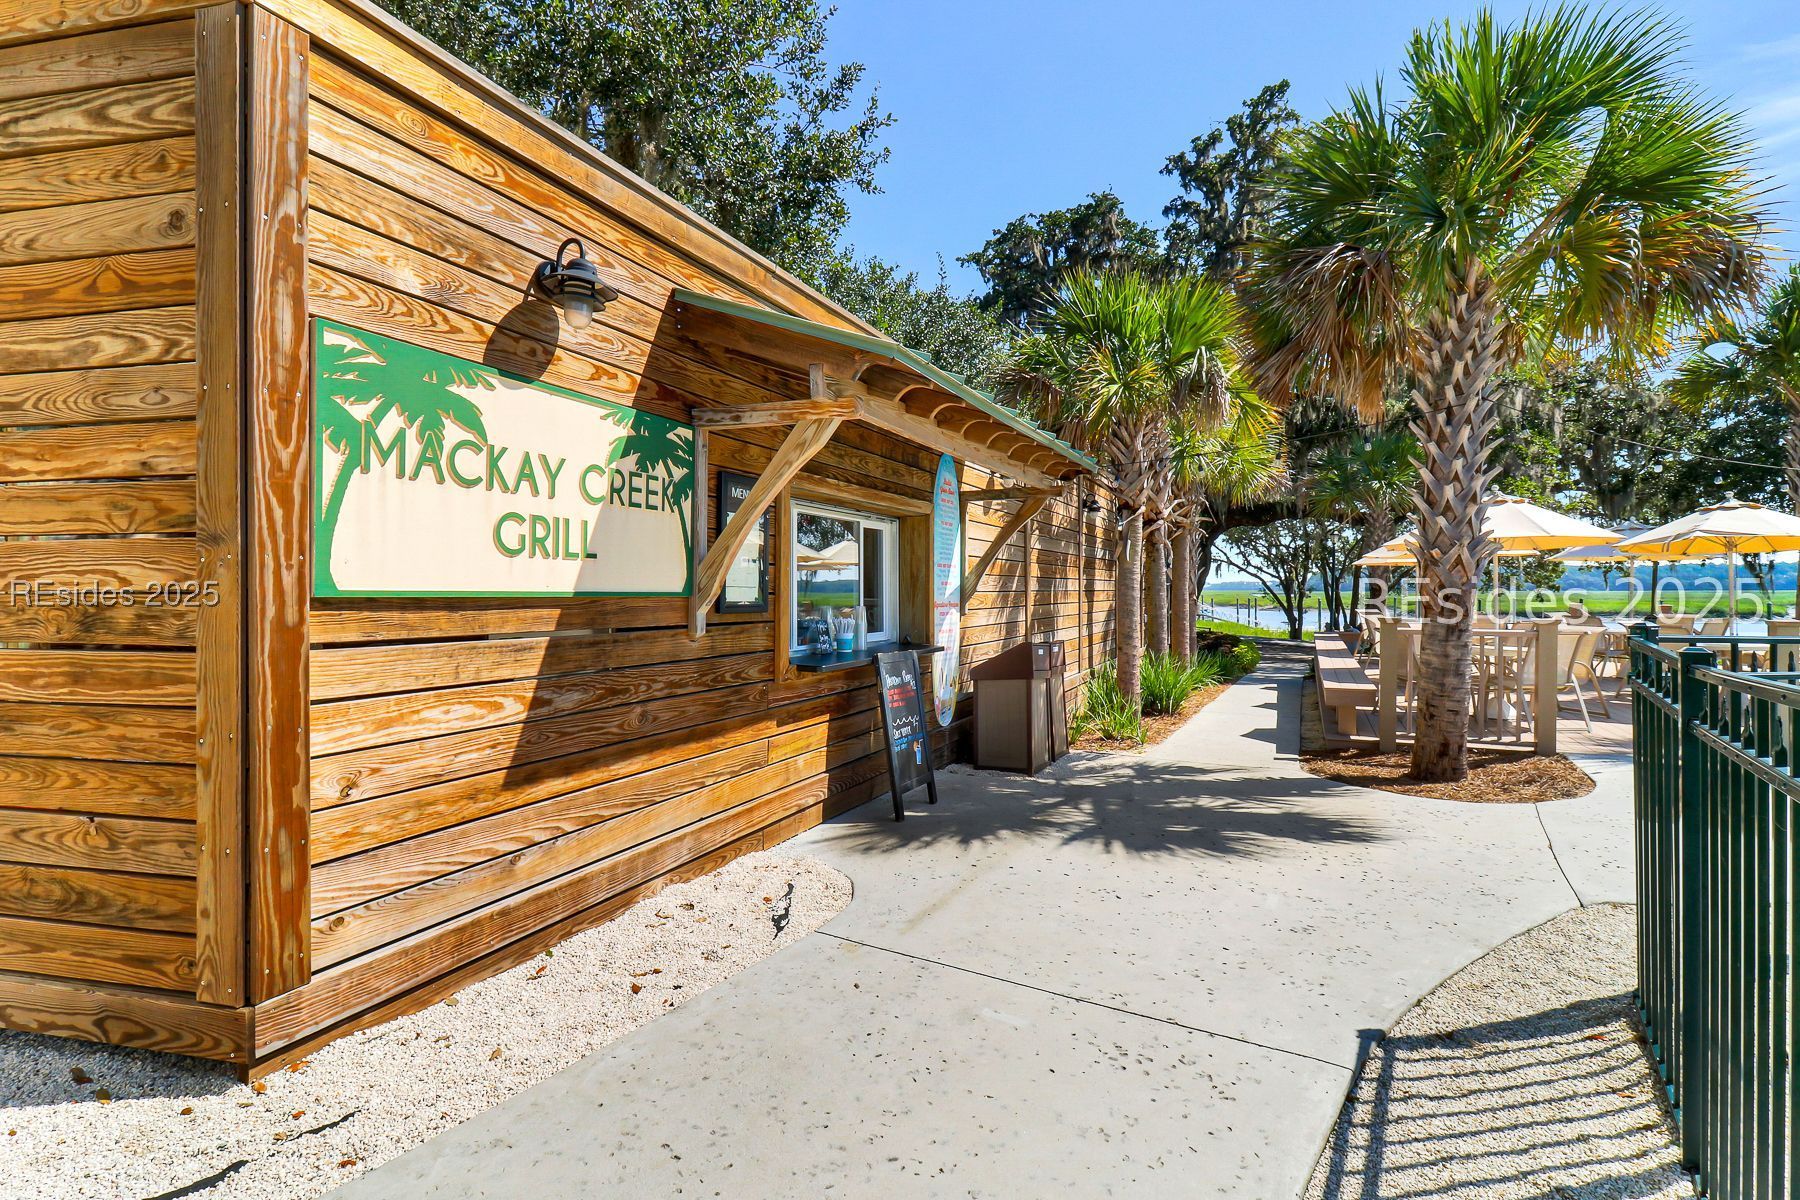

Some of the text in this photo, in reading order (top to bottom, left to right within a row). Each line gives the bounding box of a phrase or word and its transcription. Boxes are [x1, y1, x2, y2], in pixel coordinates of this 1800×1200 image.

[361, 419, 675, 513] MACKAY CREEK
[731, 486, 752, 499] MEN
[492, 511, 598, 561] GRILL
